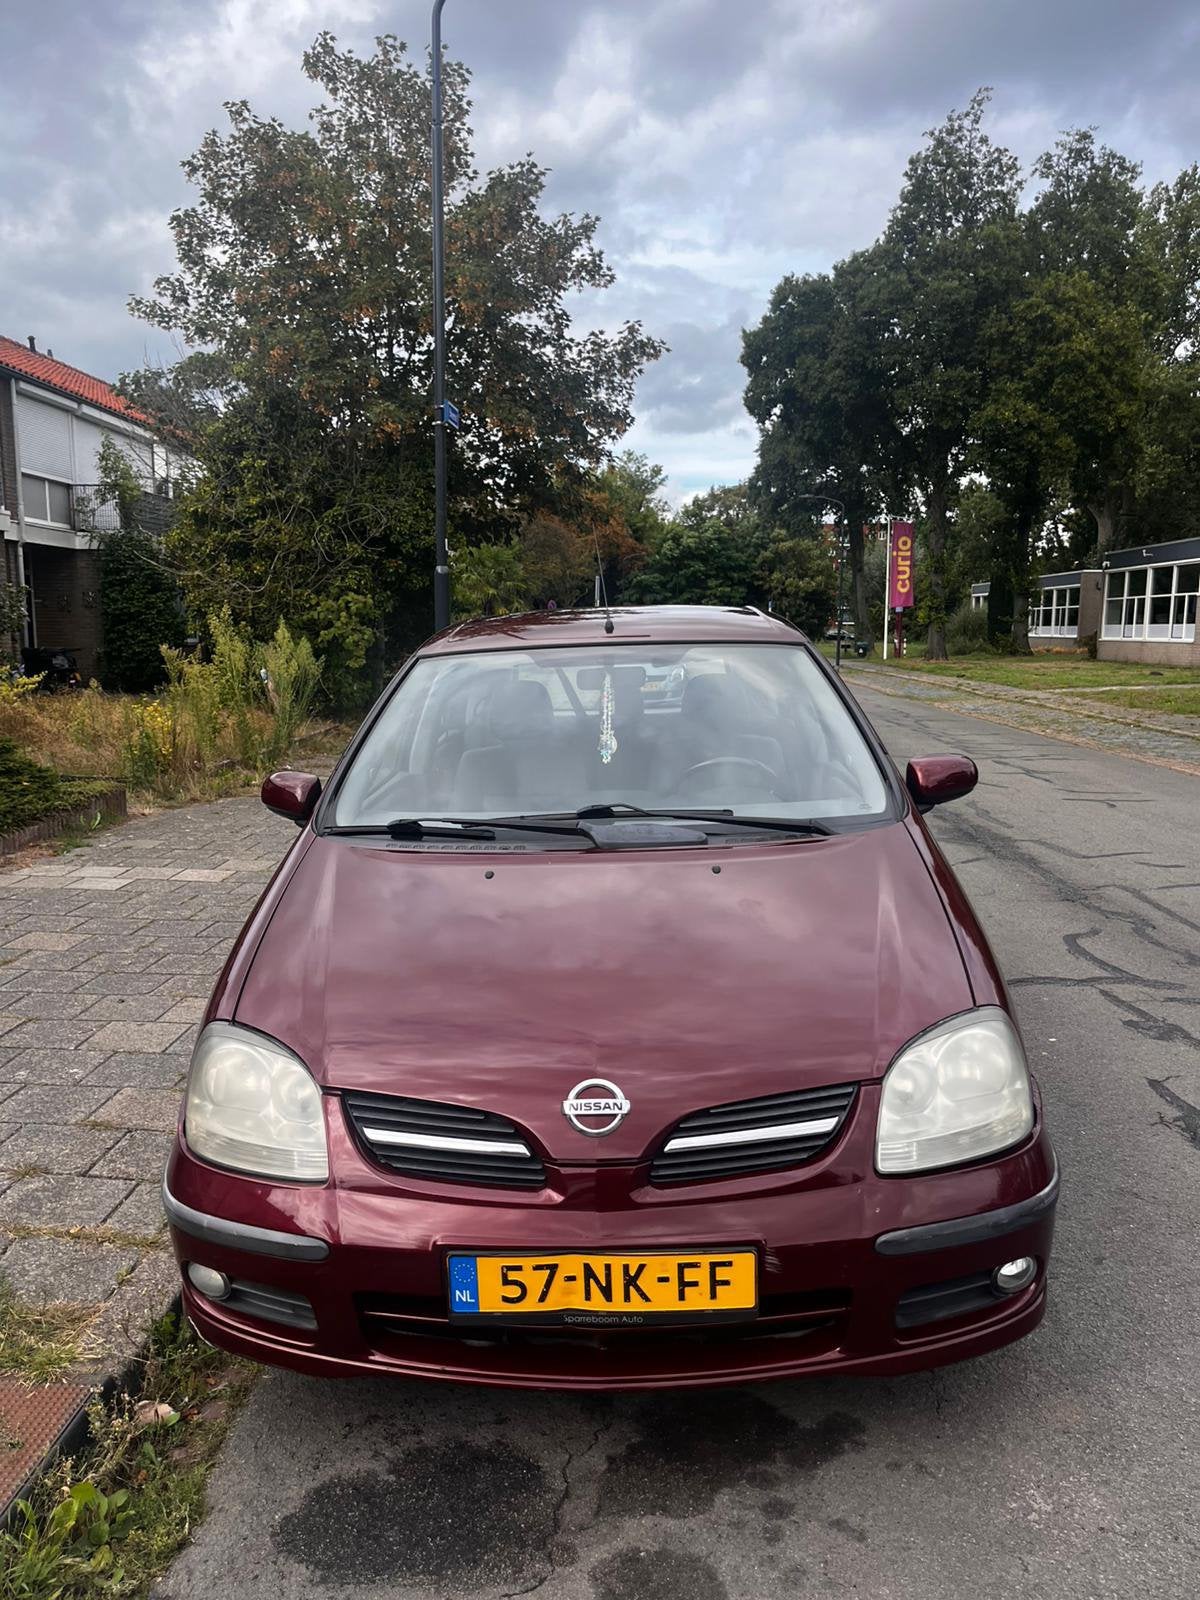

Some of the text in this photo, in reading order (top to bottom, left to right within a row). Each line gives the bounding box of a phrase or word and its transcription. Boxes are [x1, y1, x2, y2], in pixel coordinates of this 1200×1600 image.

[893, 536, 912, 593] curio
[569, 1101, 623, 1112] NISSAN
[500, 1260, 733, 1304] 57-NK-FF
[455, 1289, 476, 1303] NL
[563, 1314, 644, 1324] Sparreboom Auto
